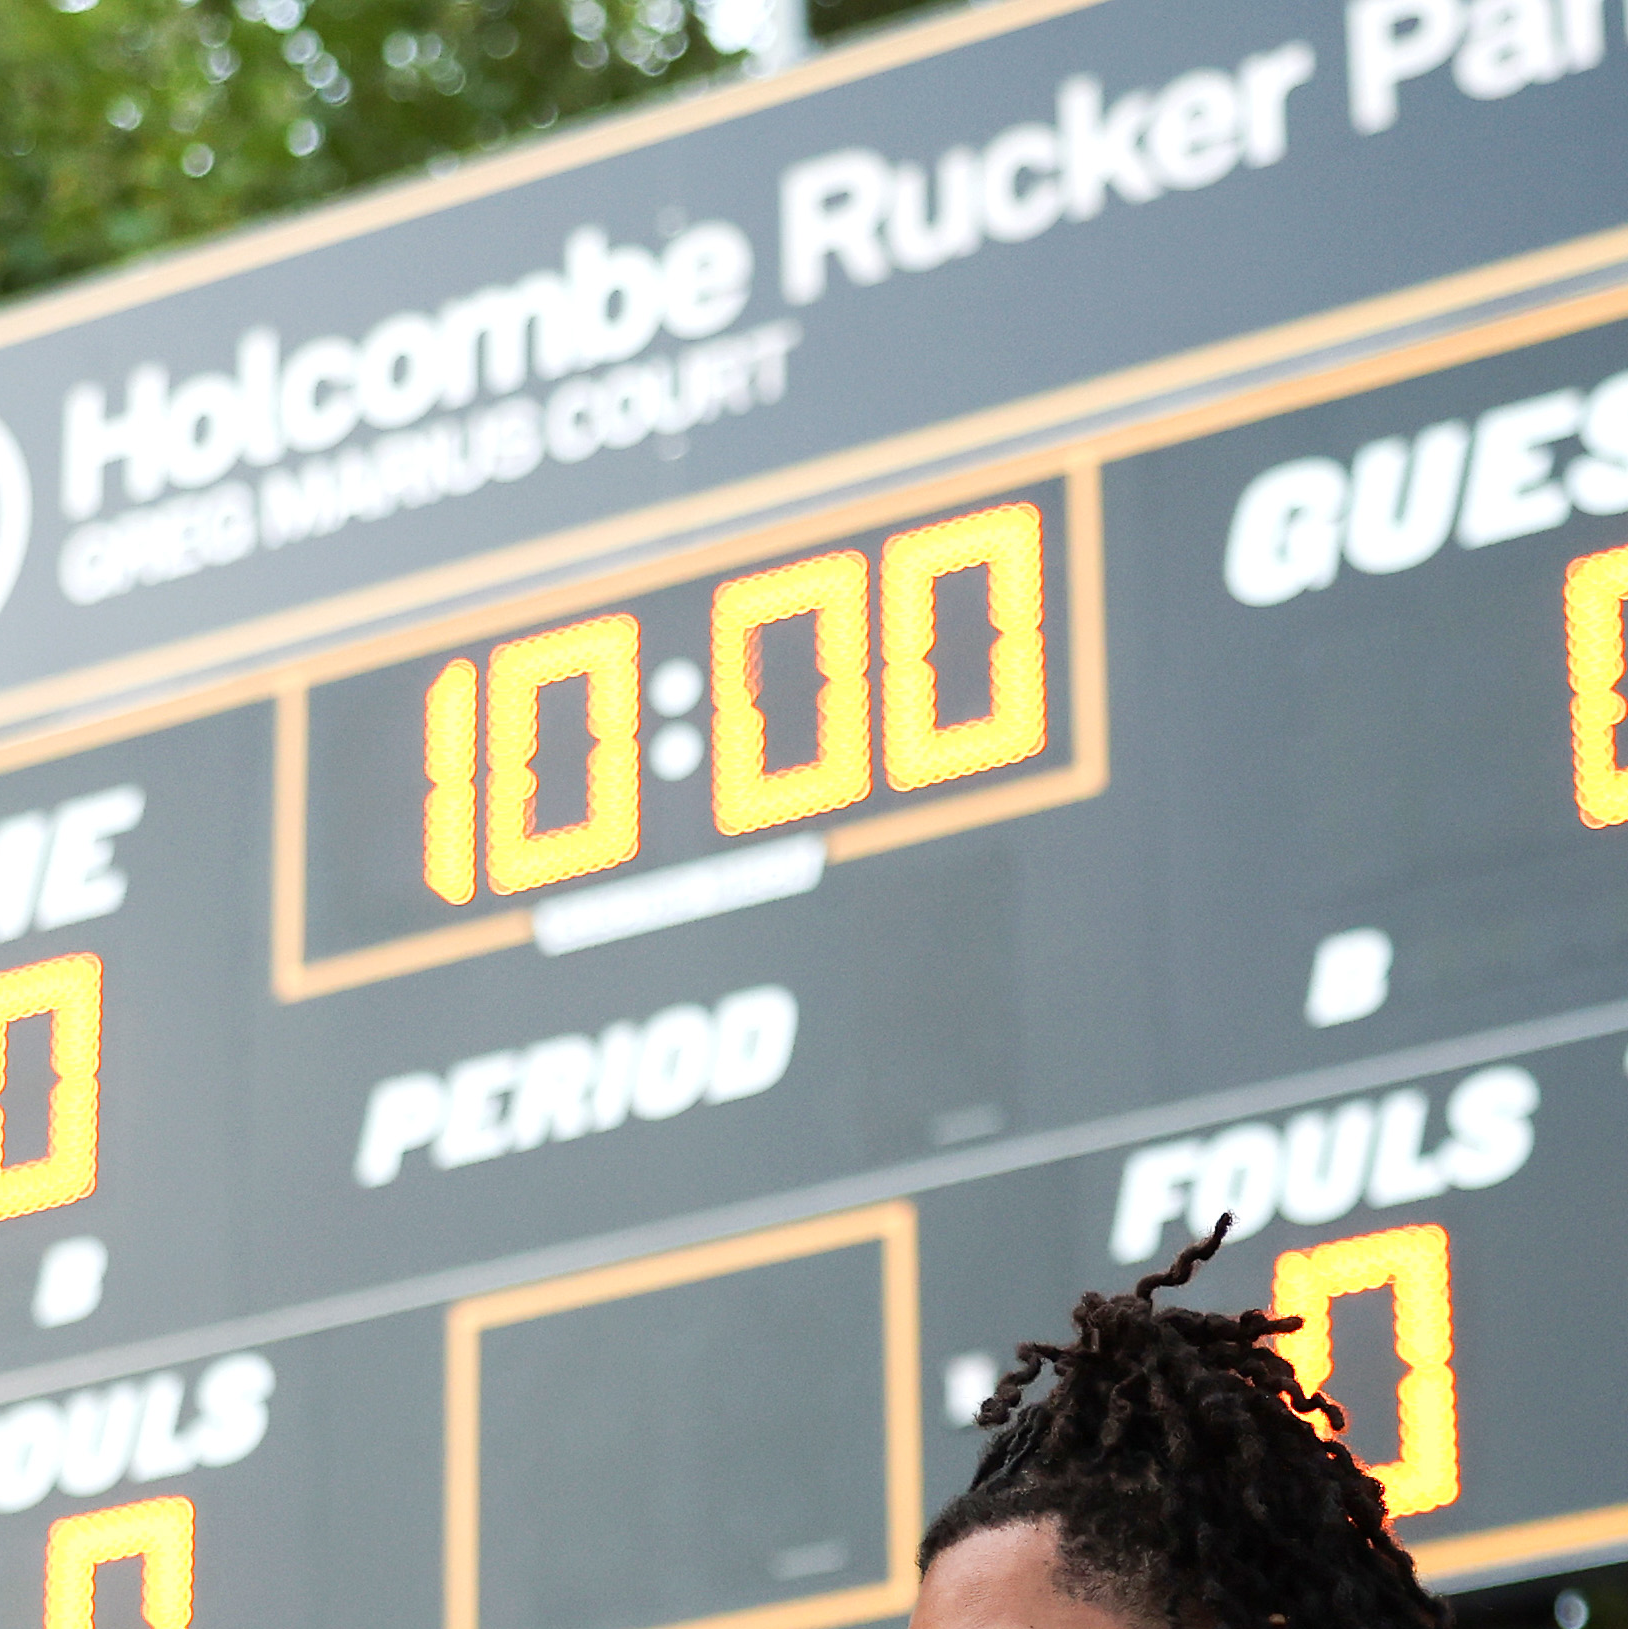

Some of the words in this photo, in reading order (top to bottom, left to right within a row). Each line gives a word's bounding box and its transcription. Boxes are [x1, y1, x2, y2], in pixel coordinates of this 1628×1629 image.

[61, 218, 757, 522] Holcombe
[777, 40, 1317, 306] Rucker
[545, 318, 803, 464] COURT
[424, 502, 1046, 905] 10:00
[1305, 925, 1394, 1030] B
[353, 984, 801, 1189] PERIOD
[1107, 1064, 1541, 1266] FOULS
[32, 1236, 109, 1330] B
[1273, 1223, 1461, 1520] 0
